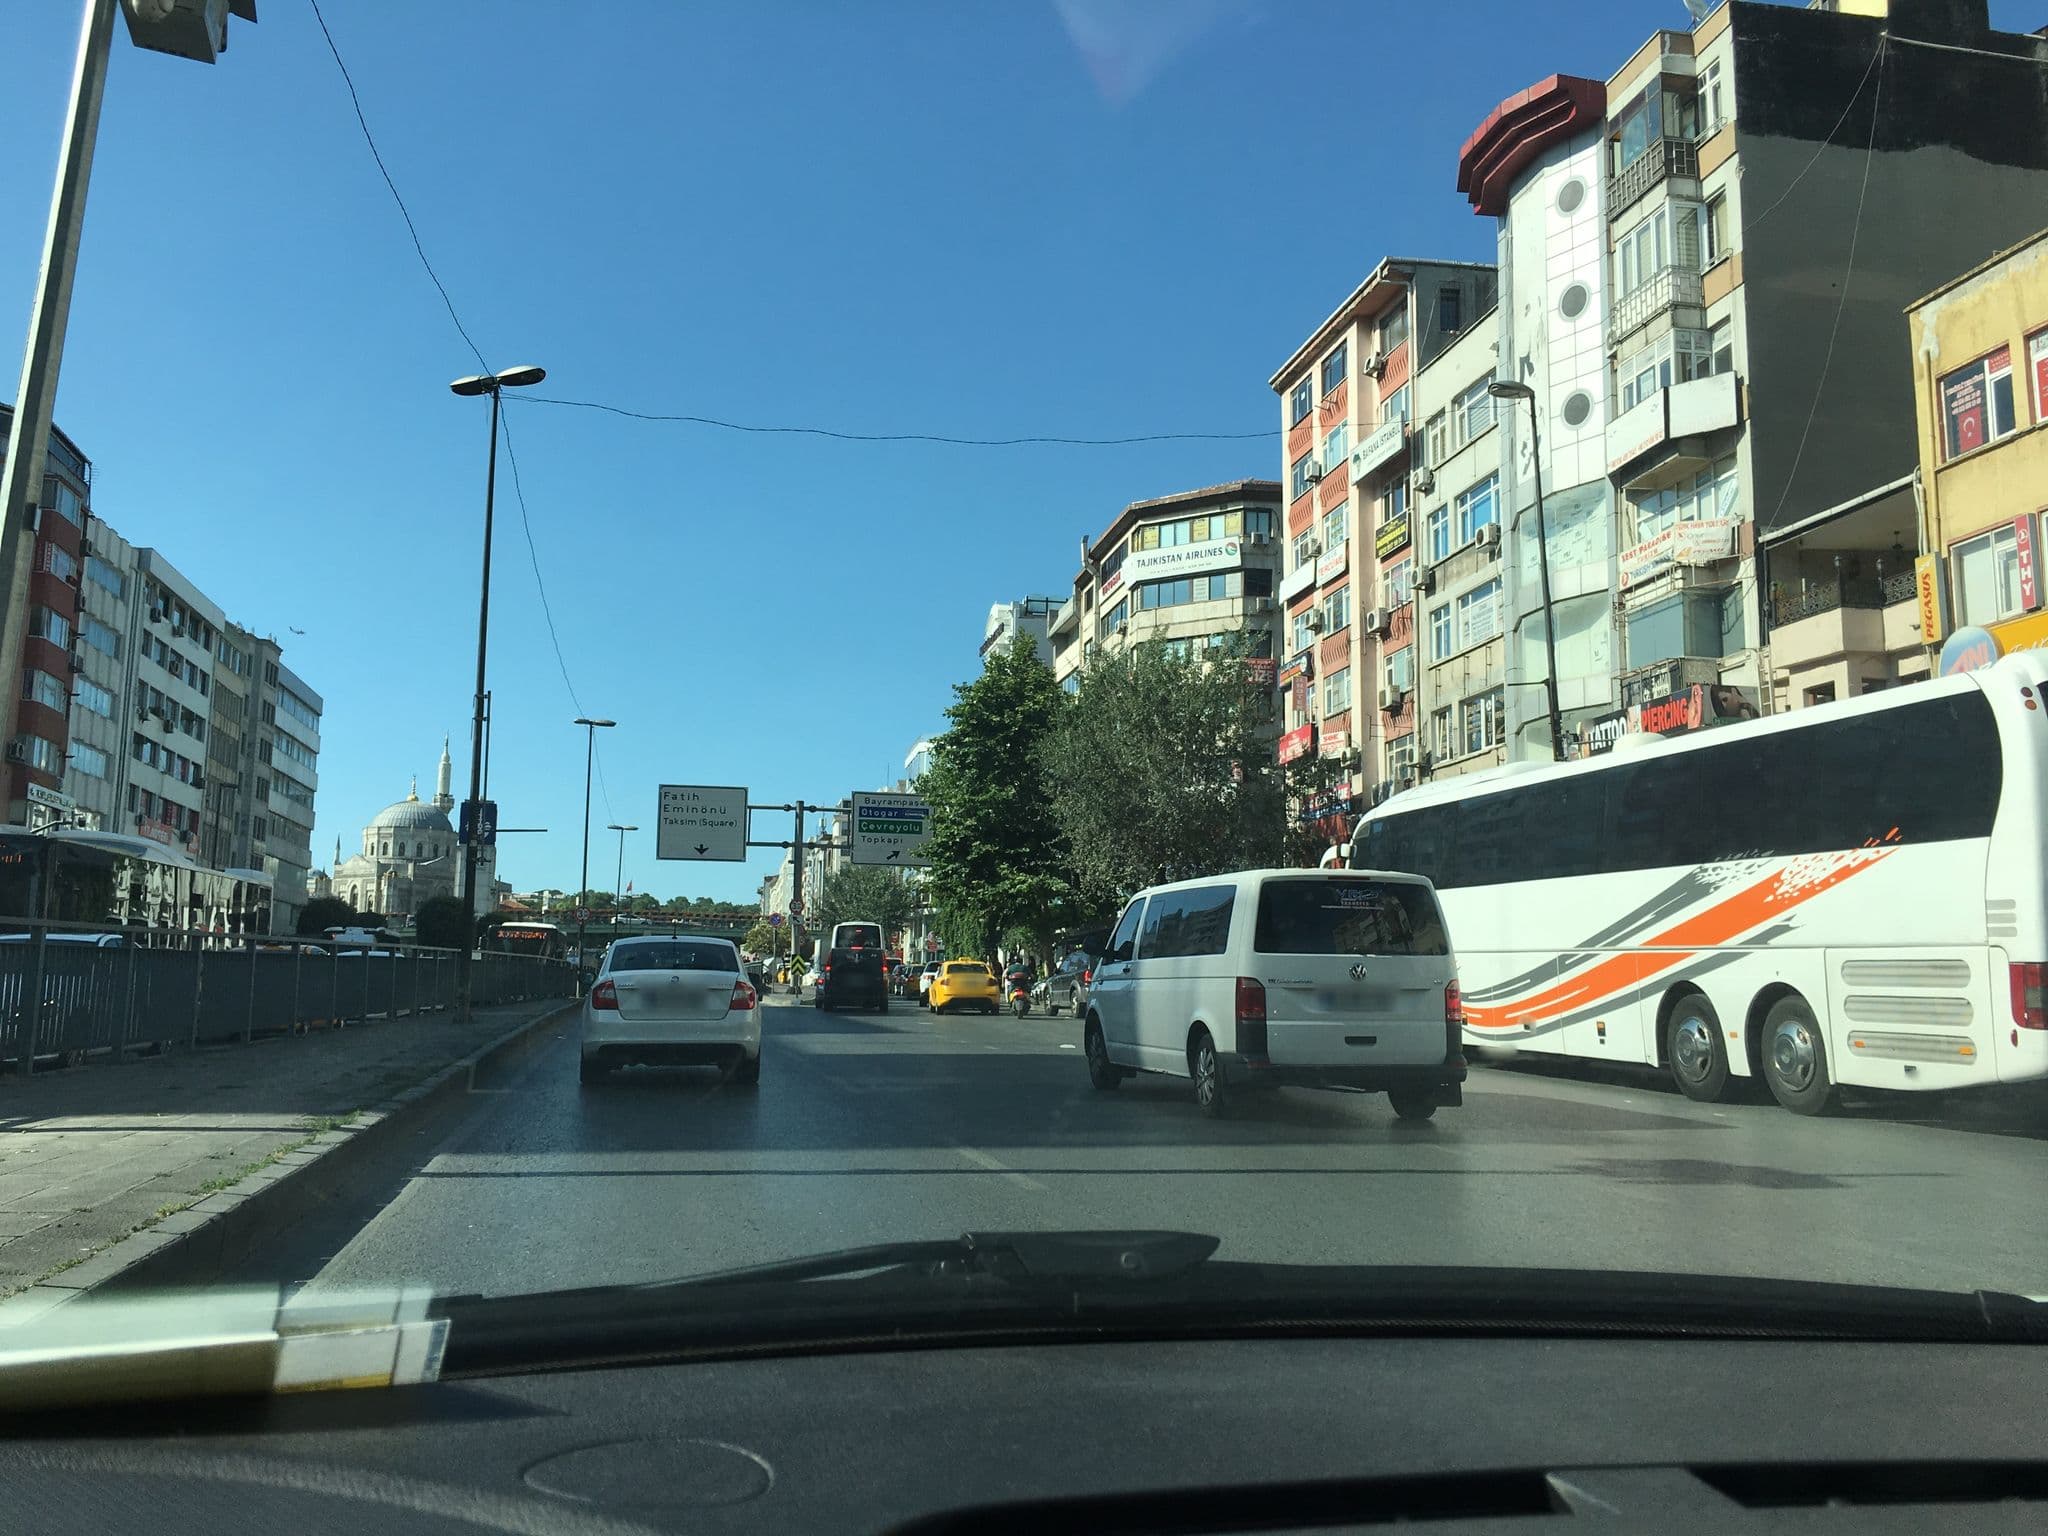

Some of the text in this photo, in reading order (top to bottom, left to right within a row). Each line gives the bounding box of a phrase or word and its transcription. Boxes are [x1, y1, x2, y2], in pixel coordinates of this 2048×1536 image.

[1136, 553, 1183, 569] TAJIKISTAN
[1185, 547, 1223, 561] AIRLINES
[2019, 549, 2033, 596] THY
[1921, 572, 1935, 640] PEGASUS
[1588, 716, 1628, 751] TATTOO
[663, 791, 700, 801] Fatih
[663, 803, 727, 815] Eminönü
[861, 808, 899, 818] Otogar
[663, 817, 738, 828] Taksim (Square)
[861, 821, 920, 833] Çevreyolu
